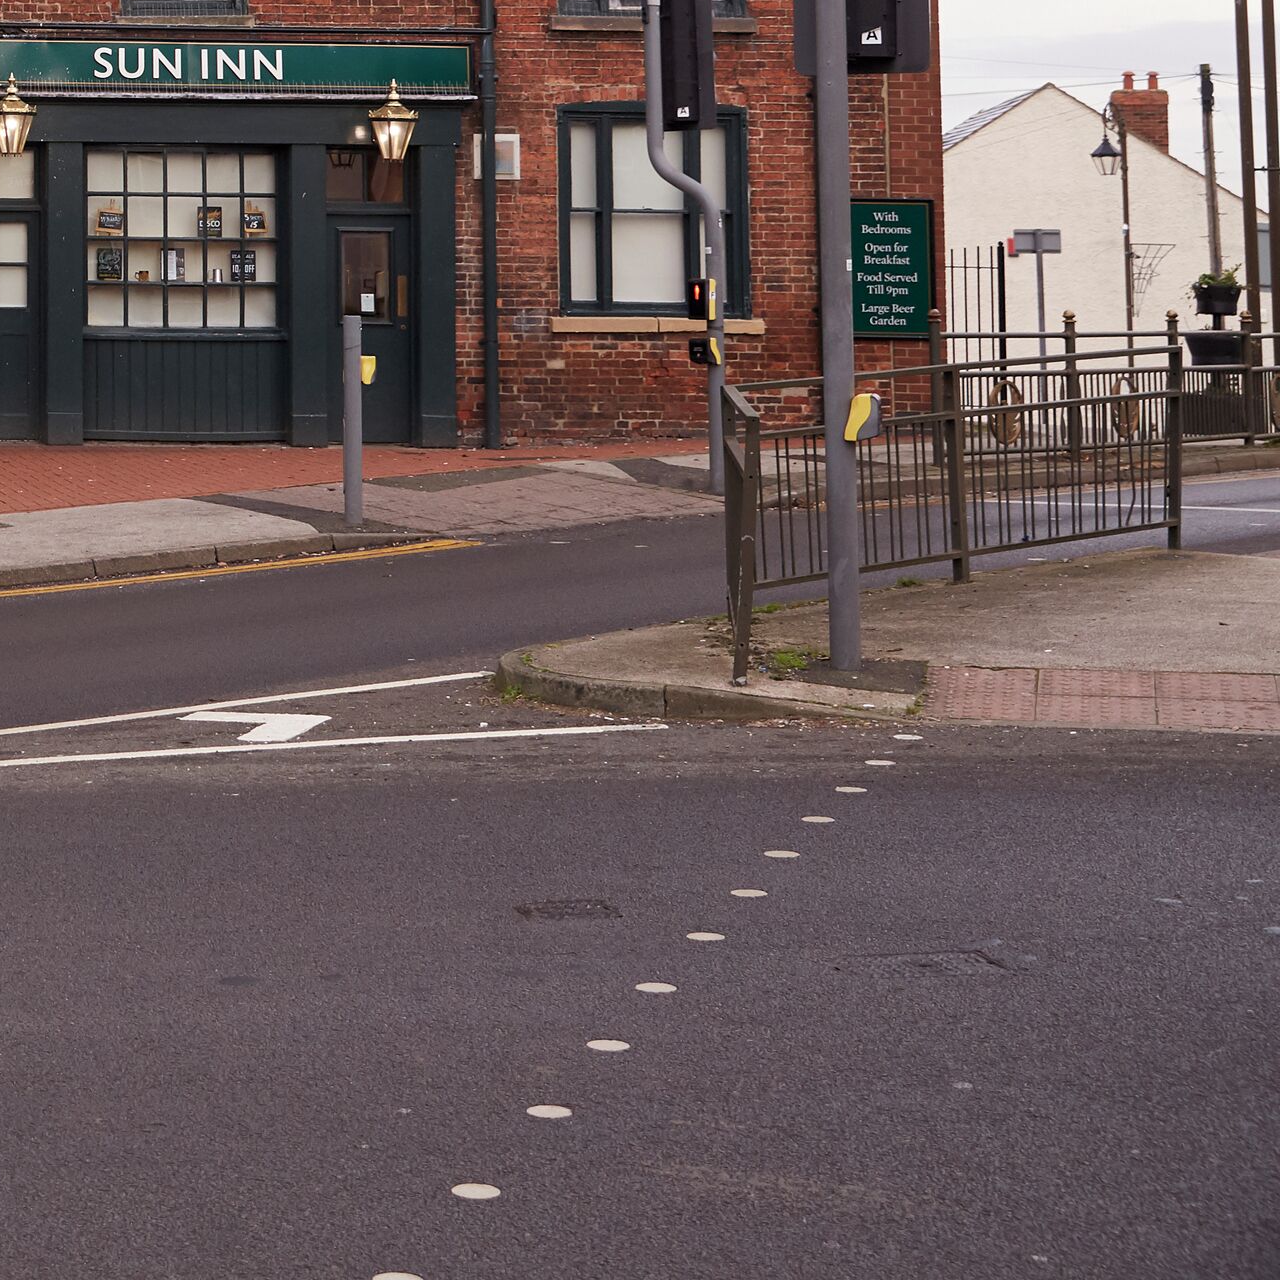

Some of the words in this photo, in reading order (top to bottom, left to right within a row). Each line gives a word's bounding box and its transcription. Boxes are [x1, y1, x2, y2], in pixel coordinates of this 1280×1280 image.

[865, 30, 878, 41] A
[93, 46, 182, 80] SUN
[200, 48, 284, 81] INN
[680, 107, 687, 115] A
[872, 211, 899, 222] With
[861, 224, 912, 235] Bedrooms
[864, 242, 892, 254] Open
[893, 242, 909, 253] for
[863, 255, 910, 265] Breakfast
[244, 264, 255, 273] OFF
[856, 272, 882, 282] Food
[883, 272, 918, 283] Served
[866, 284, 884, 295] Till
[885, 285, 909, 297] 9pm
[861, 303, 890, 314] Large
[891, 303, 915, 314] Beer
[869, 316, 907, 326] Garden
